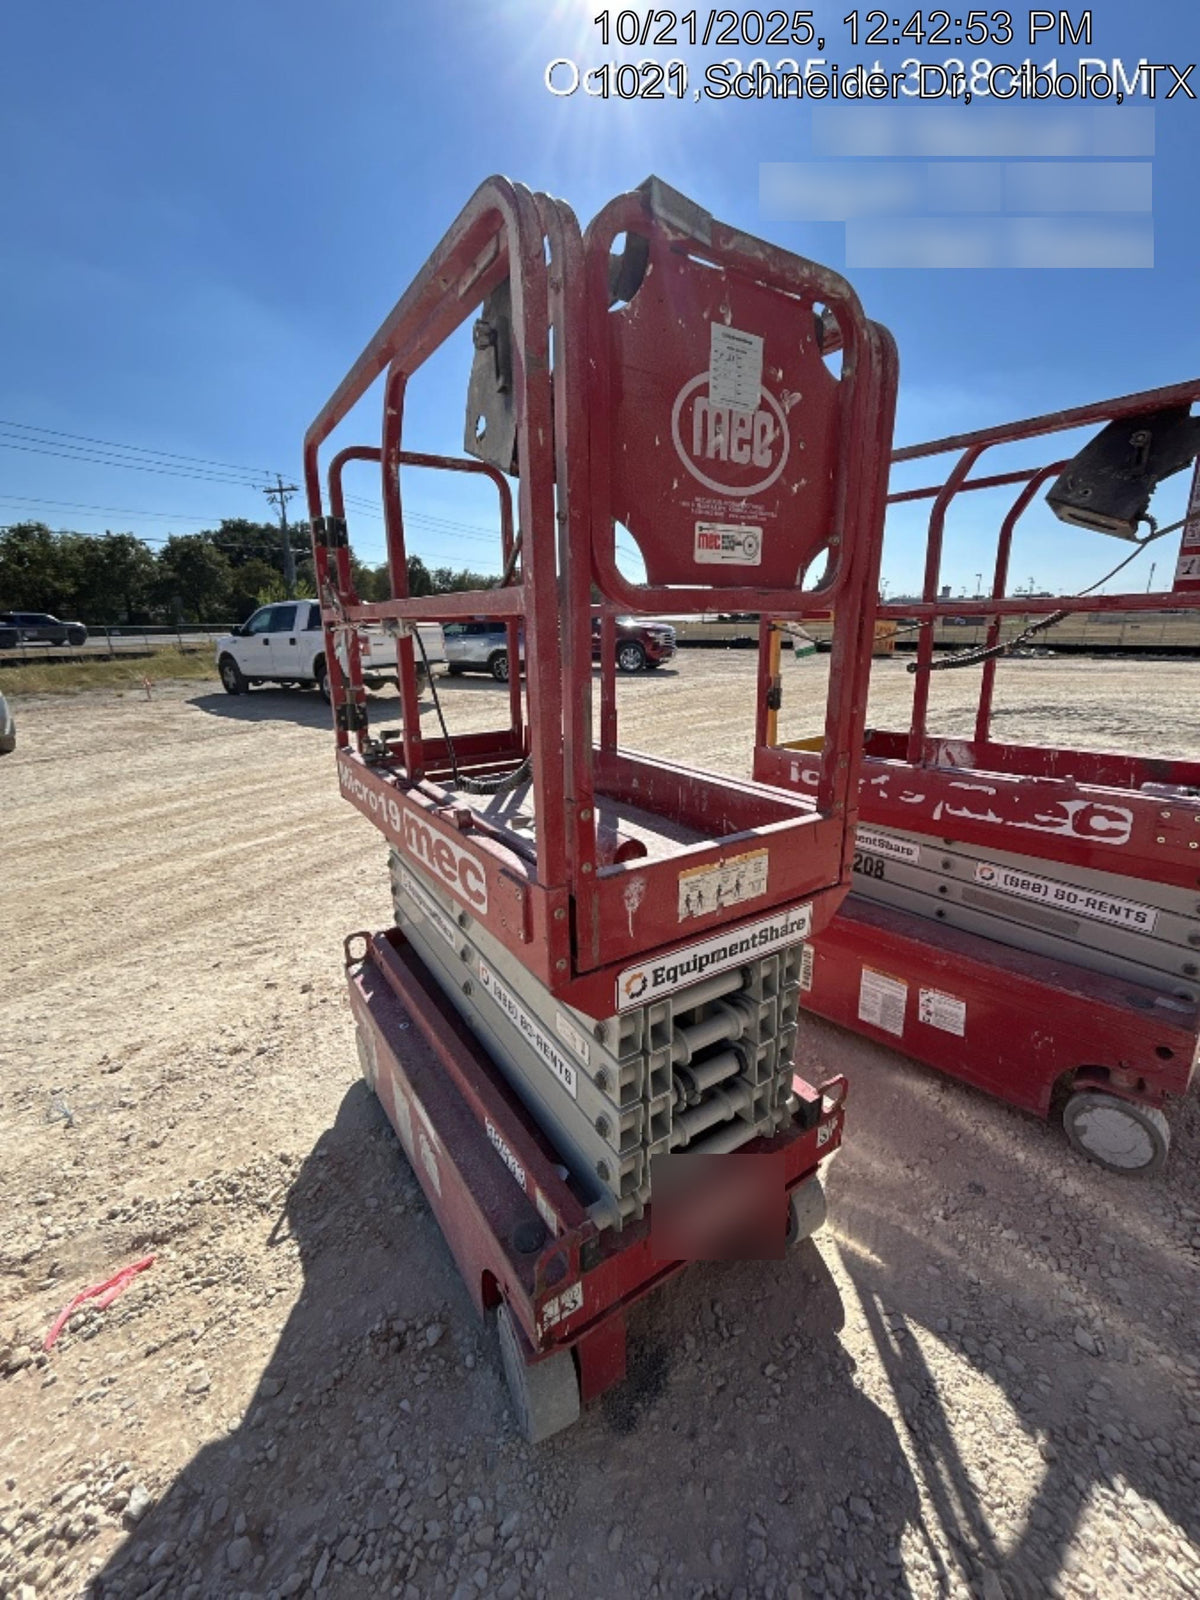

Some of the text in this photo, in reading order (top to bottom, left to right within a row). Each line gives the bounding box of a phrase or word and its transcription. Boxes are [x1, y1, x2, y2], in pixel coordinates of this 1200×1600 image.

[338, 760, 400, 832] Micro19
[856, 834, 914, 856] entShare
[1003, 872, 1149, 925] (888) 80-RENTS
[650, 917, 808, 988] EquipmentShare
